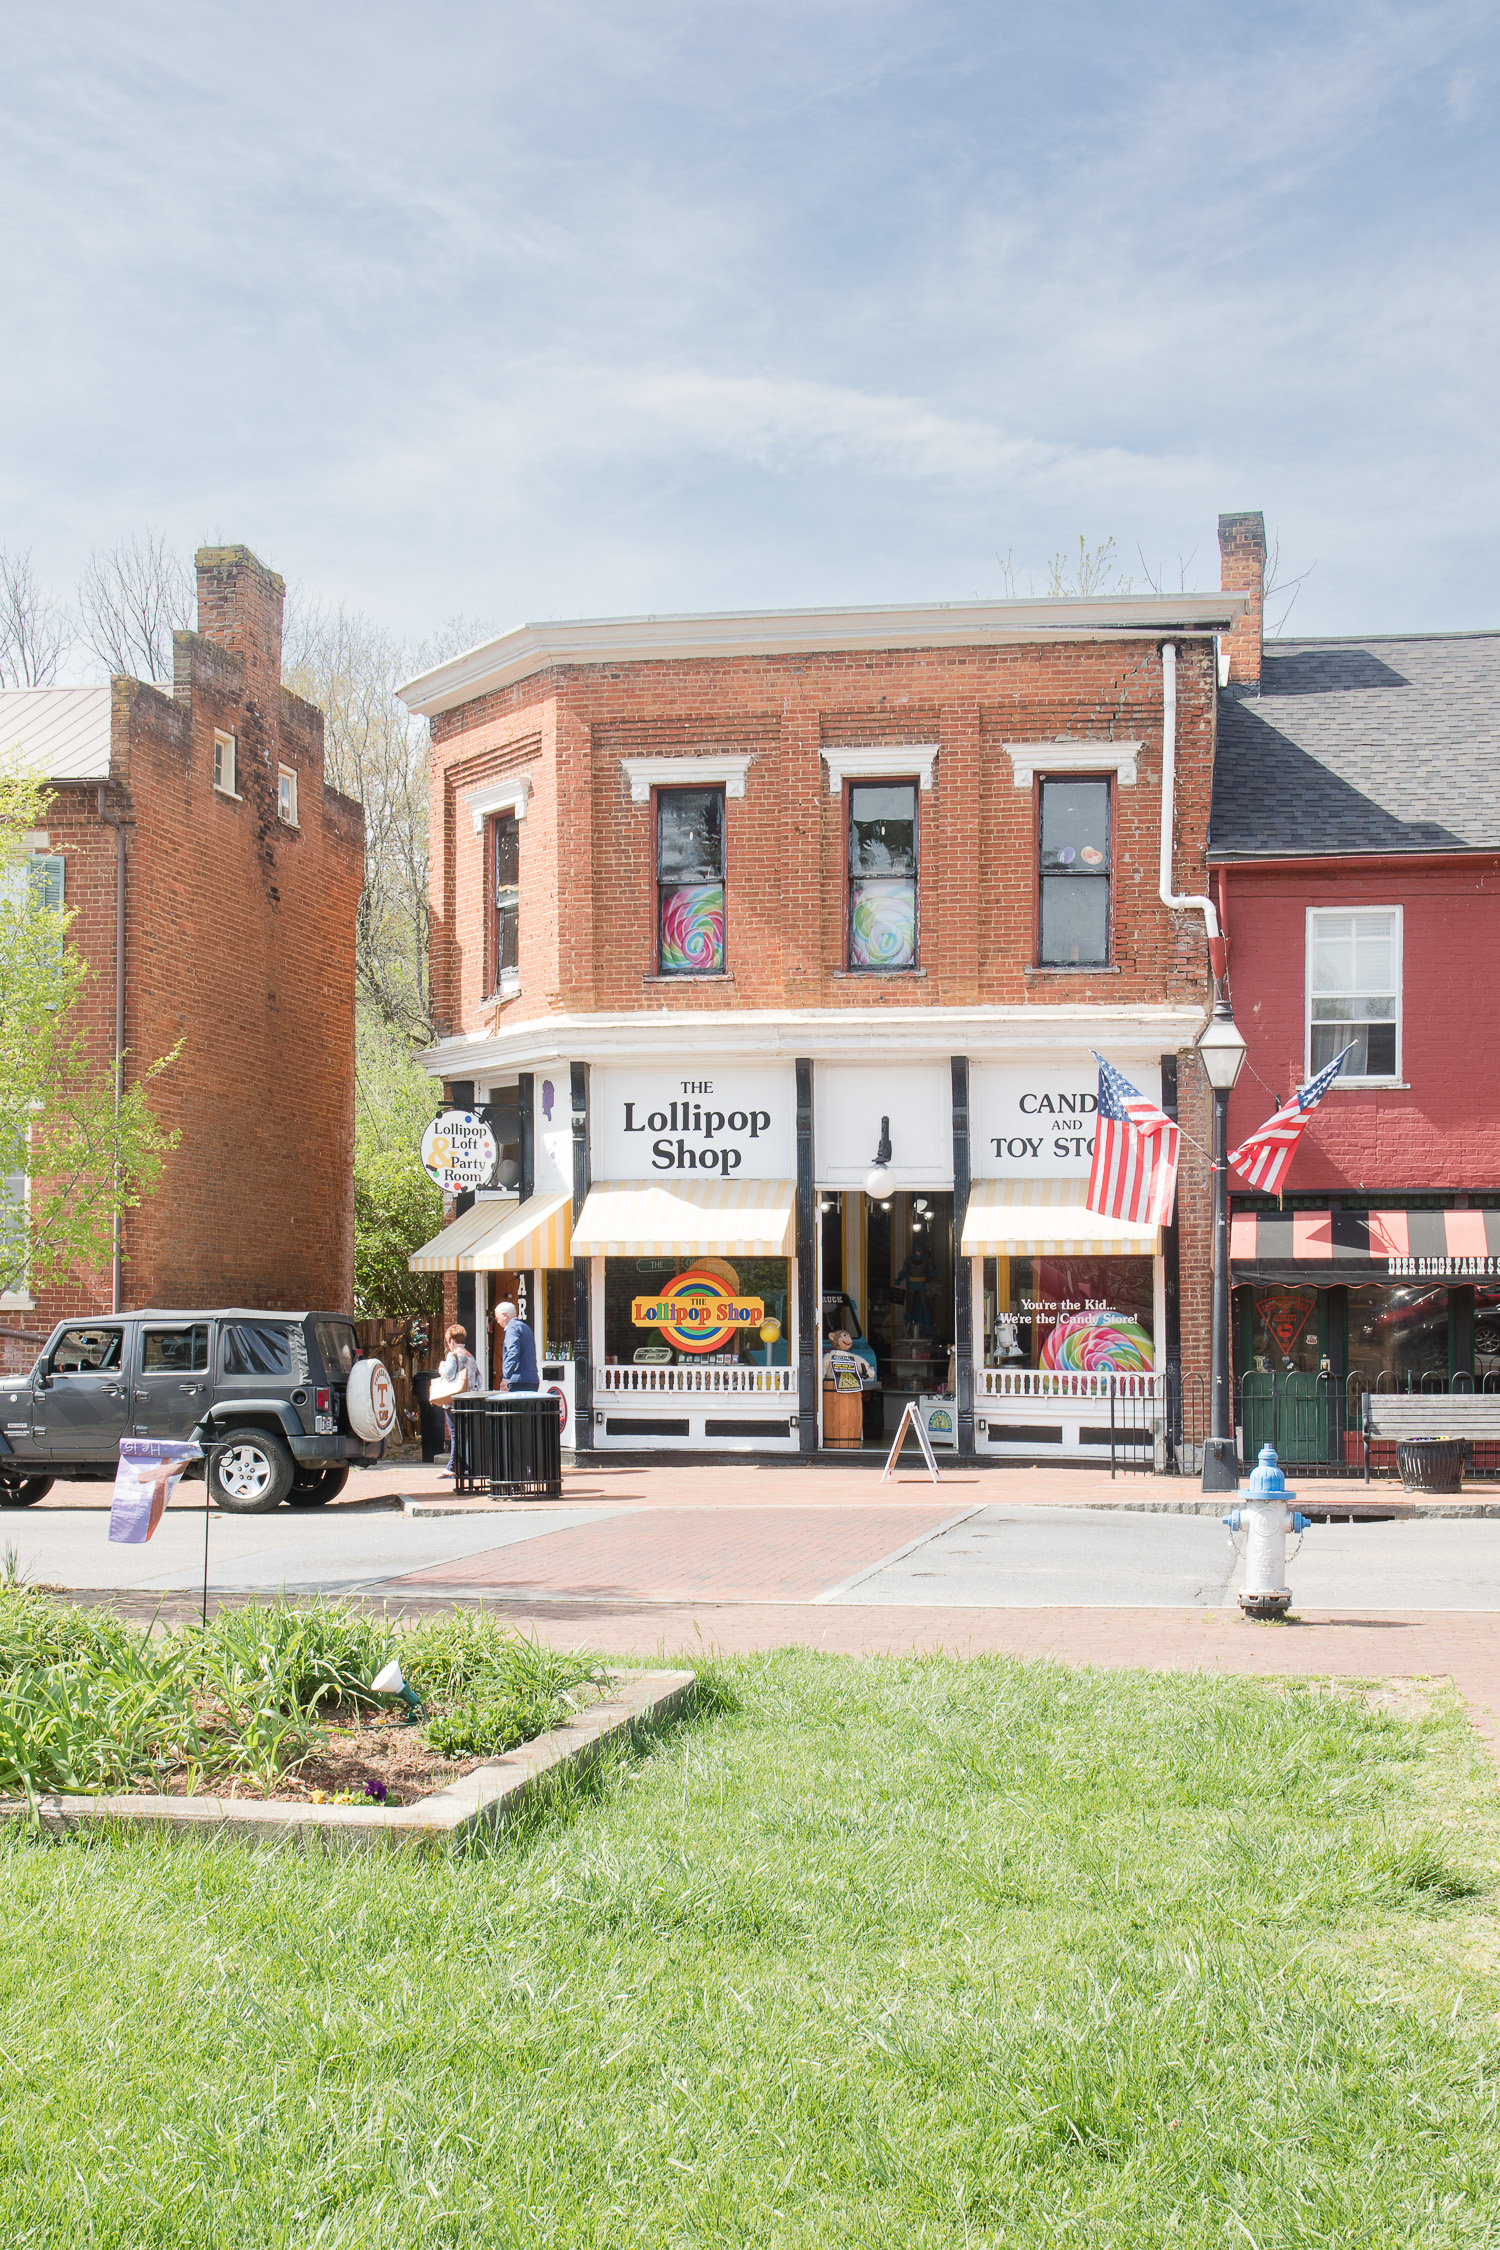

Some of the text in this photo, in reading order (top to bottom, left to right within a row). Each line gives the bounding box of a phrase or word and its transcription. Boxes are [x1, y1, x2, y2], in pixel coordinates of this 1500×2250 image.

[680, 1081, 714, 1094] THE
[1019, 1093, 1098, 1114] CAND
[623, 1101, 771, 1138] Lollipop
[1051, 1119, 1083, 1130] AND
[434, 1122, 487, 1139] Lollipop
[451, 1137, 478, 1149] Loft
[990, 1137, 1044, 1158] TOY
[428, 1137, 458, 1168] &
[651, 1139, 742, 1176] Shop
[451, 1156, 486, 1172] Party
[444, 1169, 482, 1182] Room
[650, 1260, 664, 1269] THE
[1388, 1257, 1416, 1275] DEER
[1418, 1257, 1452, 1275] RIDGE
[1454, 1257, 1485, 1275] FARM
[1021, 1299, 1116, 1310] You're the Kid...
[634, 1302, 762, 1325] Lollipop Shop
[1000, 1313, 1138, 1327] We're the Candy Store!
[377, 1383, 388, 1408] T
[124, 1442, 161, 1456] He is
